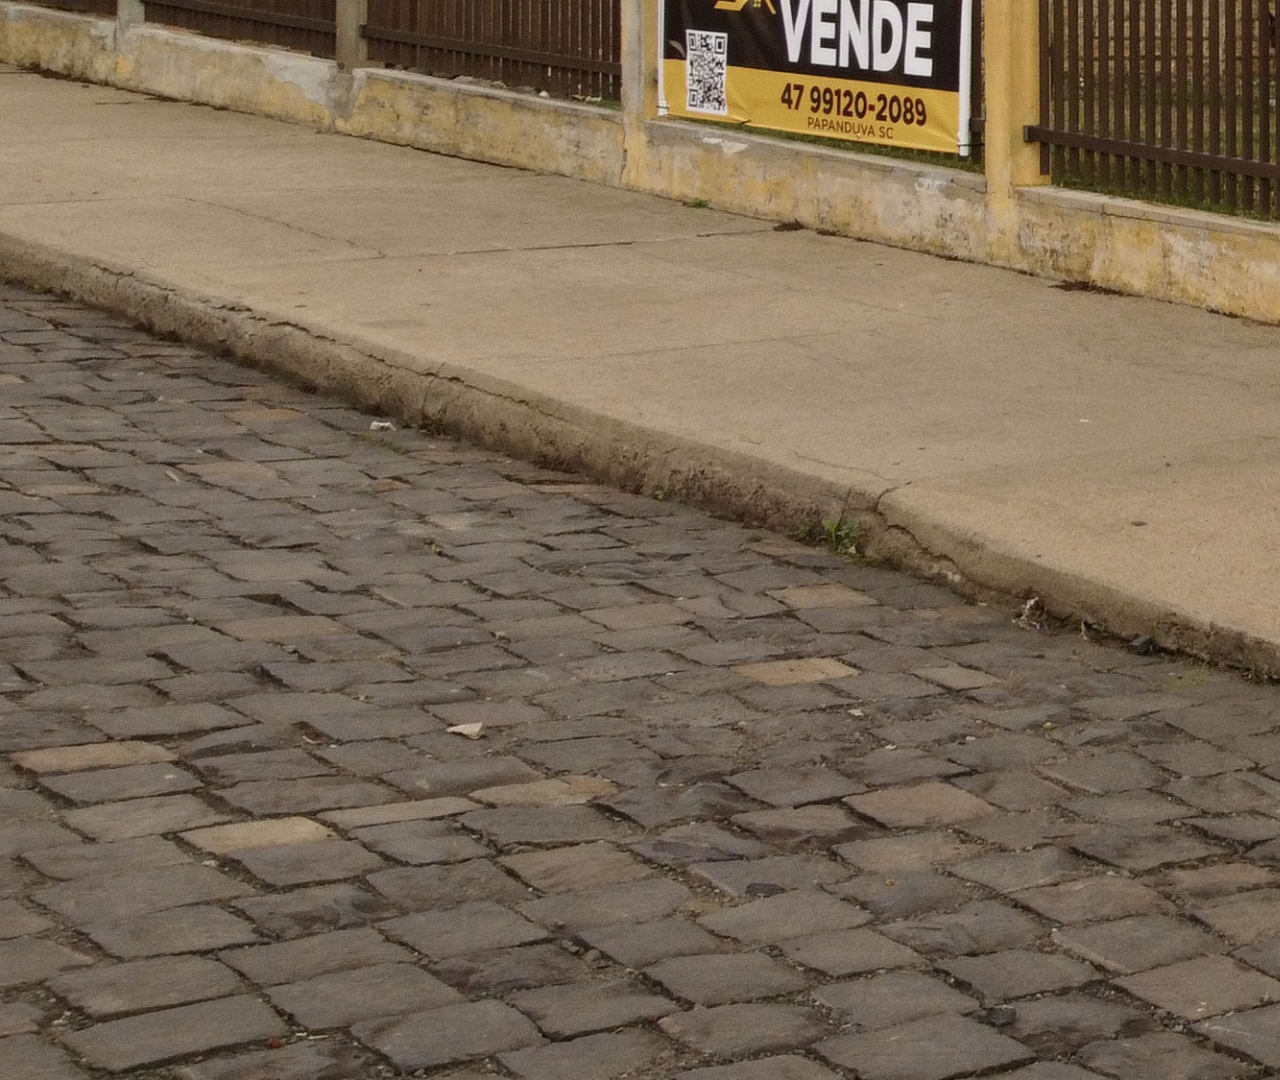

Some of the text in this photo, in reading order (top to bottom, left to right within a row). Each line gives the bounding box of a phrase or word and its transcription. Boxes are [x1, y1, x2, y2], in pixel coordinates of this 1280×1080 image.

[781, 83, 926, 126] 47 99120-2089
[808, 117, 893, 139] PAPANDUVA SC
